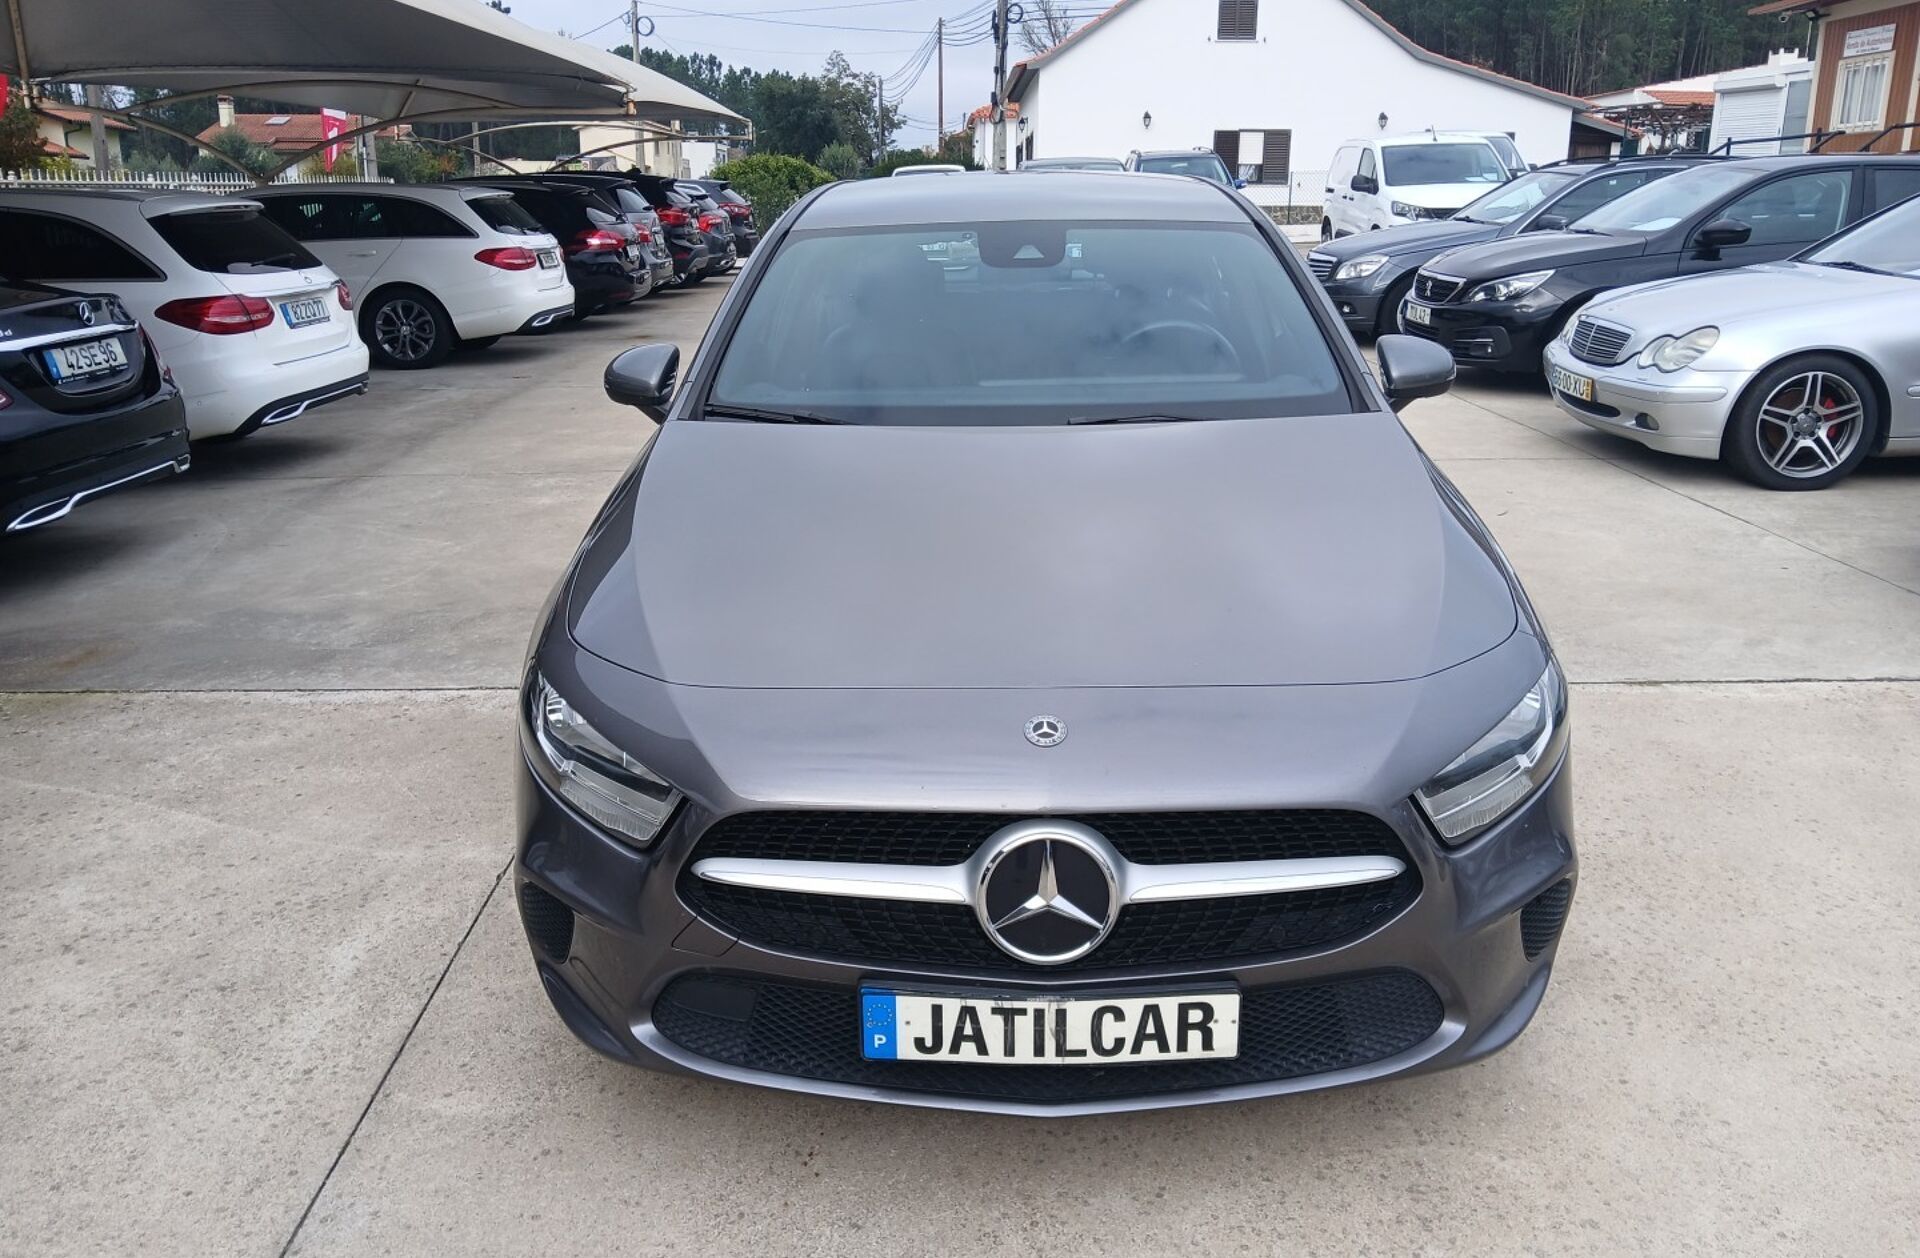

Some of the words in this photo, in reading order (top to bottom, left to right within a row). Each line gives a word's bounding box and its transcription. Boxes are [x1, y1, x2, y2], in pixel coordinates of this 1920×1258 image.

[64, 342, 118, 371] 42SE96
[874, 1034, 887, 1049] P
[913, 1002, 1215, 1058] JATILCAR
